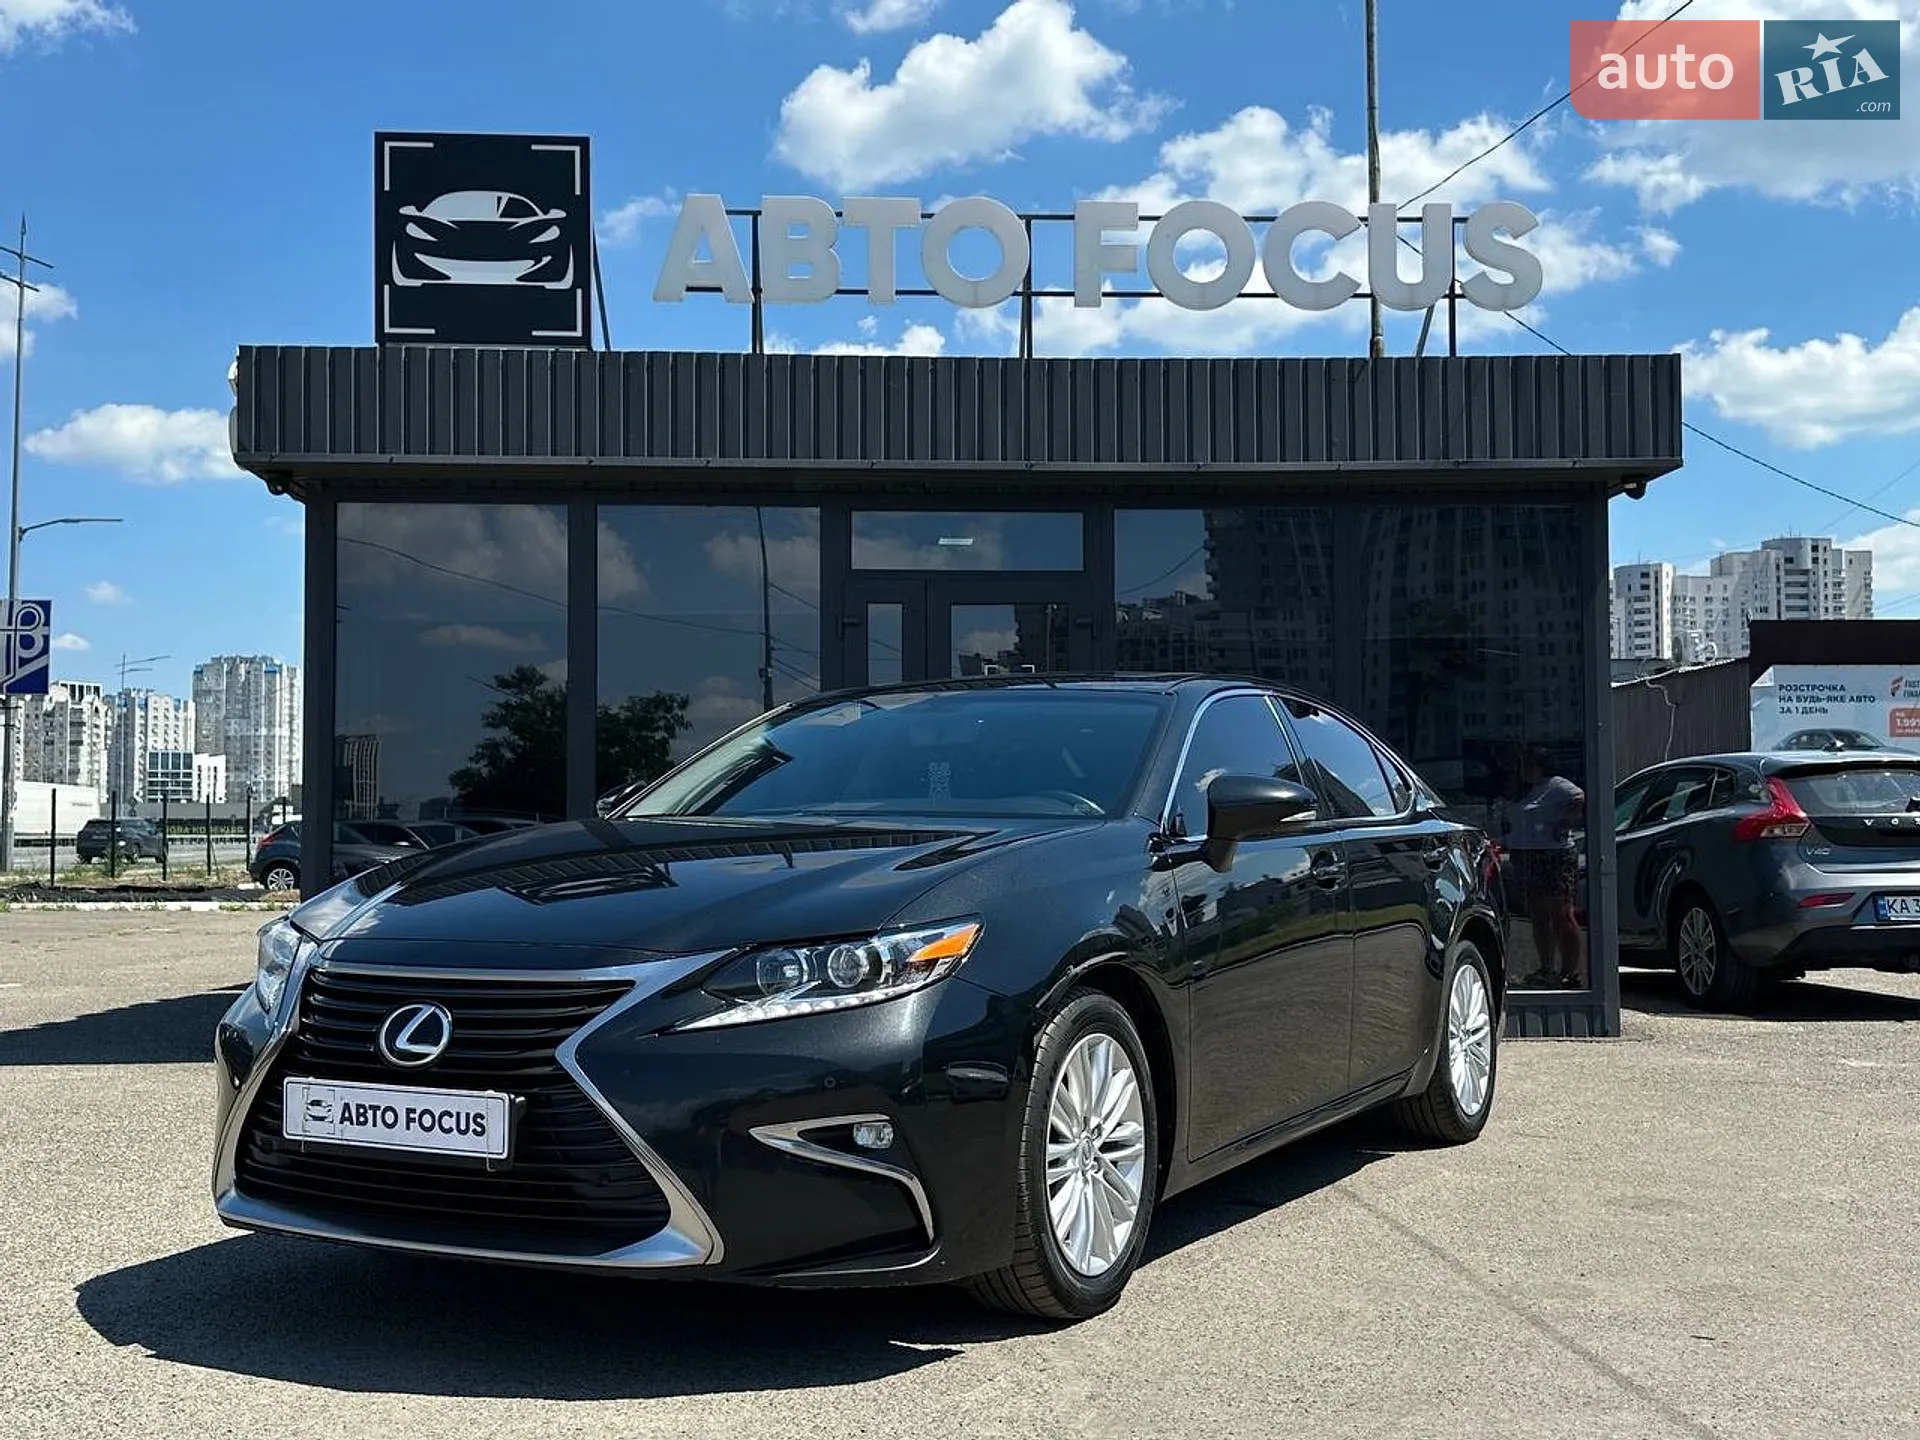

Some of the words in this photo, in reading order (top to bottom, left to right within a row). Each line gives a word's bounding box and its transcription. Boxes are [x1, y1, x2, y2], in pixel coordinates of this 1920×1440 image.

[653, 192, 1031, 309] АВТО
[1073, 199, 1543, 312] FOCUS
[1778, 683, 1846, 693] РОЗСТРОЧКА
[1778, 695, 1794, 704] НА
[1796, 695, 1847, 704] БУДЬ-ЯКЕ
[1849, 695, 1876, 704] АВТО
[1779, 706, 1793, 715] ЗА
[1801, 706, 1829, 716] ДЕНЬ
[1806, 846, 1831, 856] V40
[1886, 898, 1911, 914] KA
[339, 1102, 399, 1130] АВТО
[405, 1107, 487, 1138] FOCUS
